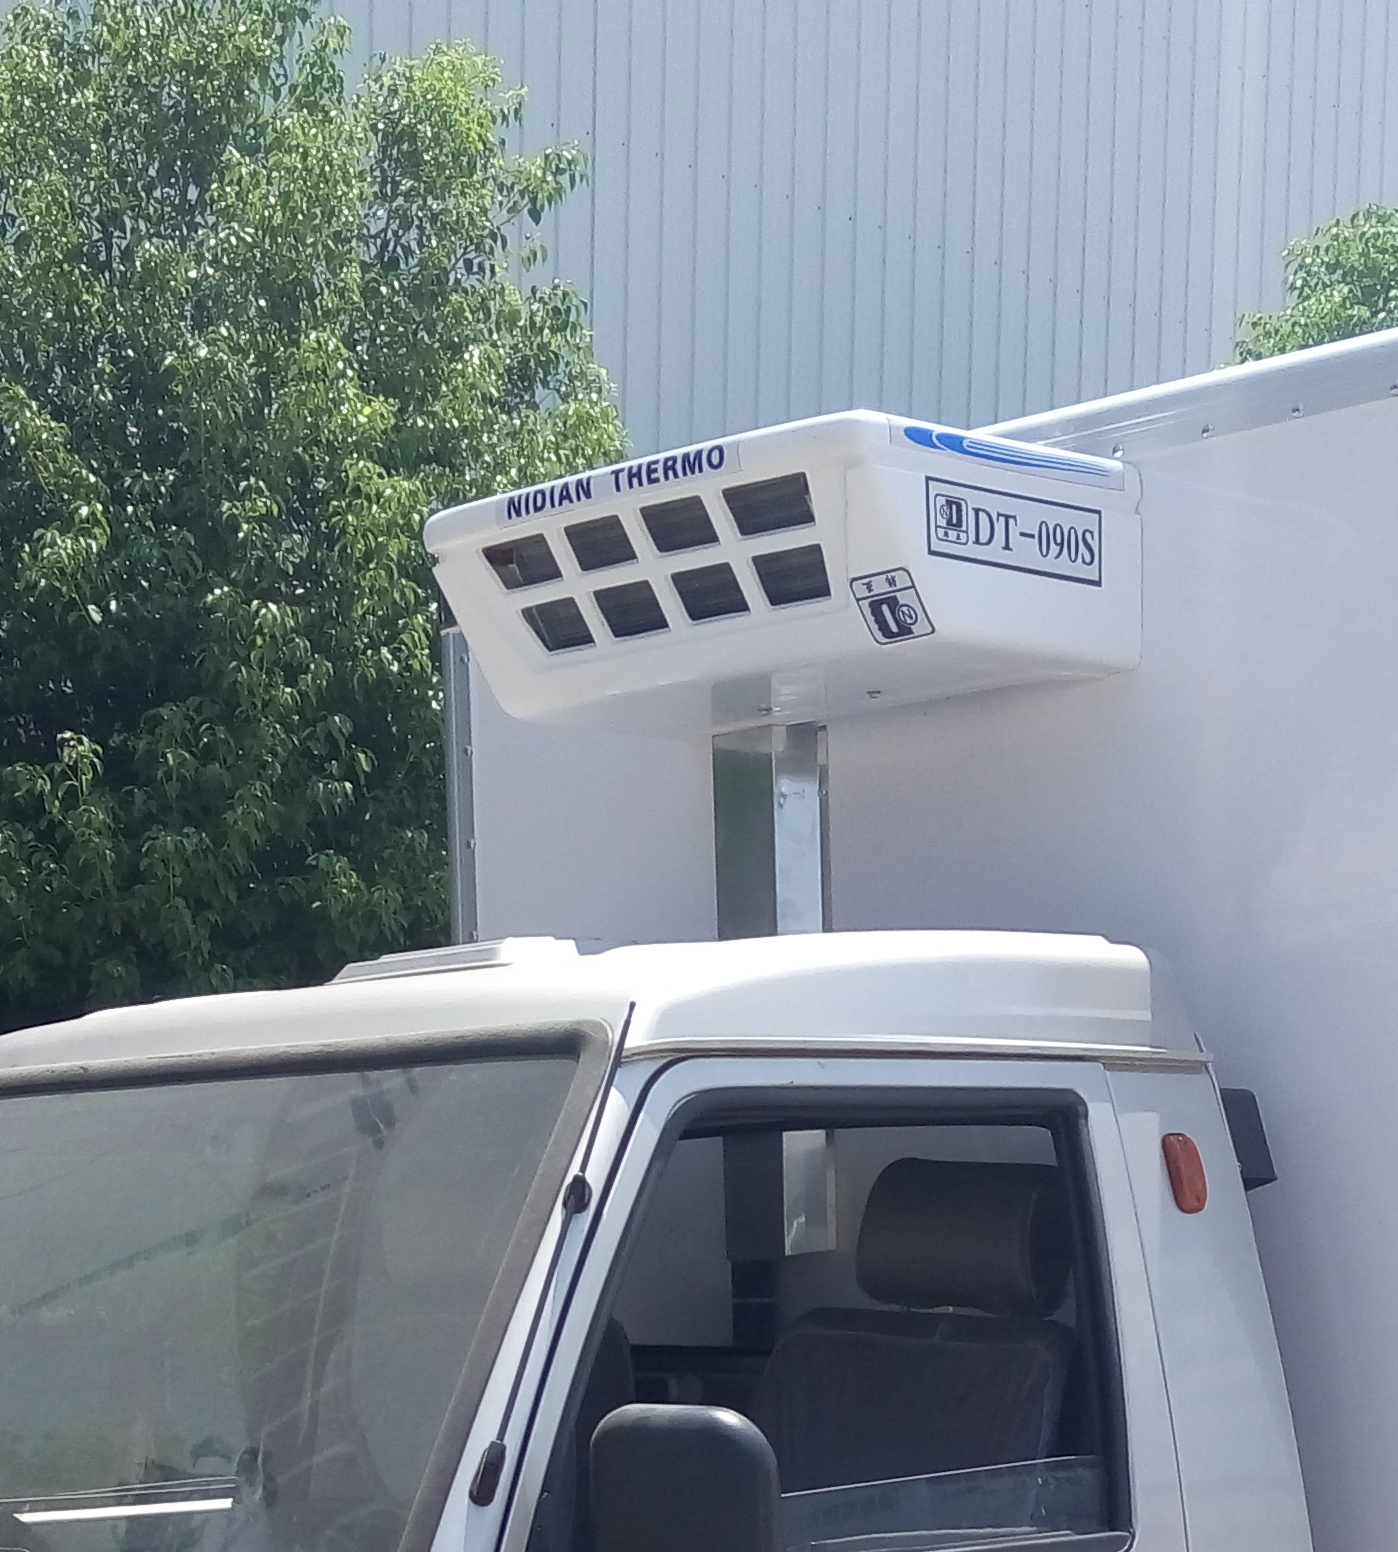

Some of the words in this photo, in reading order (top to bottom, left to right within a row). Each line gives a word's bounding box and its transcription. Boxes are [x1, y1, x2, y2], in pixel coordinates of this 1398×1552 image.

[506, 476, 594, 521] NIDIAN
[610, 444, 726, 493] THERMO
[971, 506, 1096, 567] DT-090S
